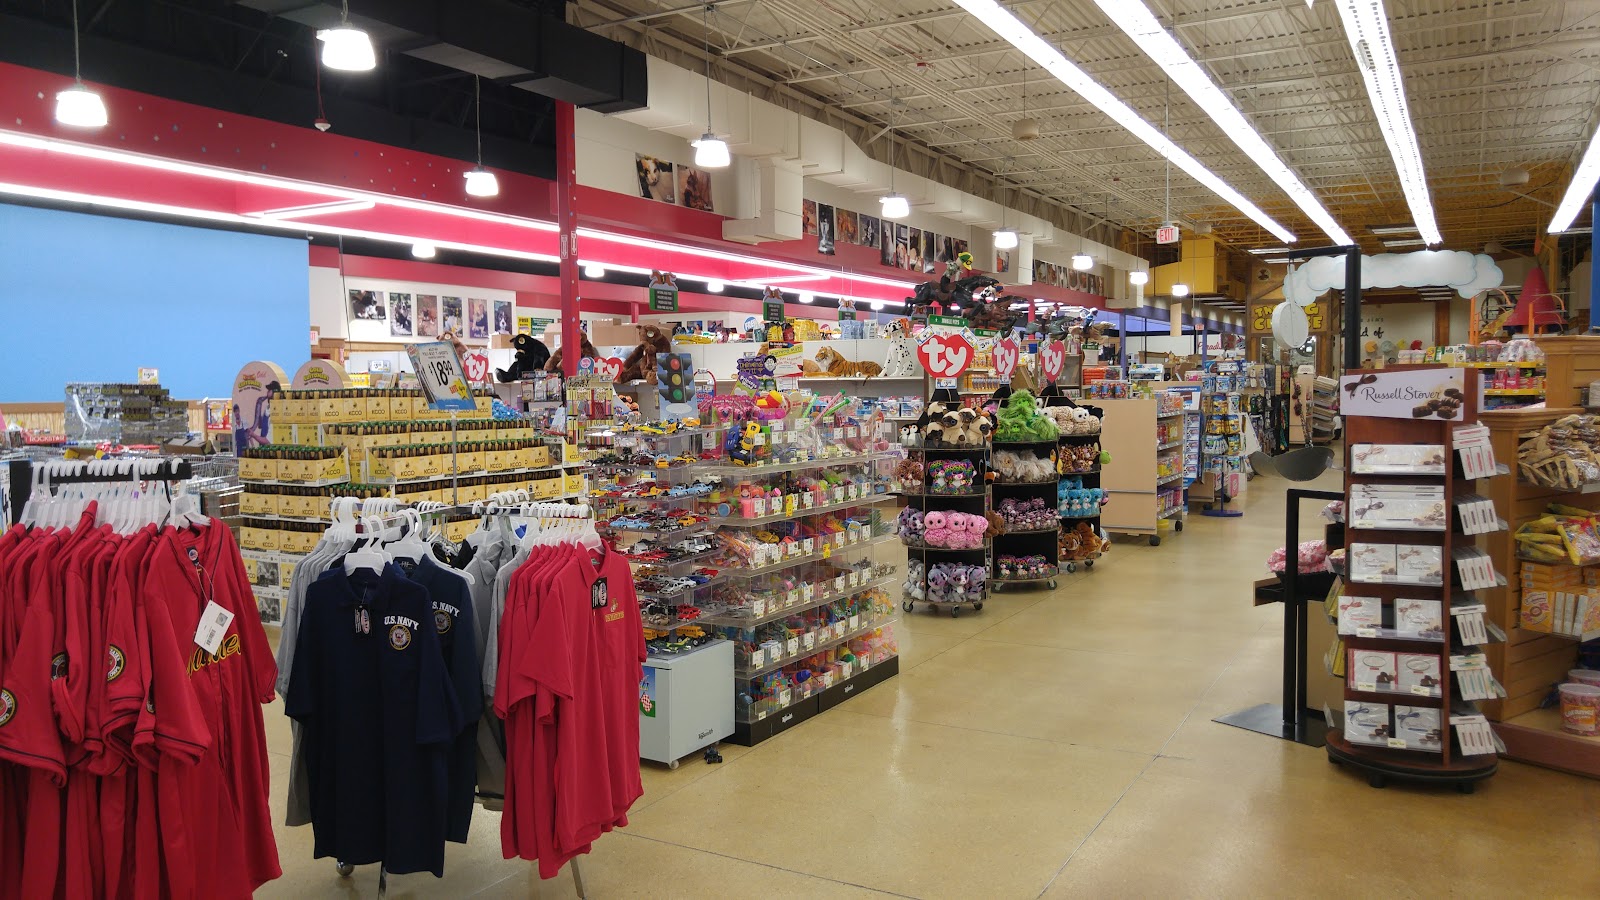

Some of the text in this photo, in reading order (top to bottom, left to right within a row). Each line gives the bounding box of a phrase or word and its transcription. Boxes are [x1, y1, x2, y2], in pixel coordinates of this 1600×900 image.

[1160, 228, 1173, 242] EXIT
[466, 354, 486, 380] ty
[922, 338, 967, 376] ty
[994, 342, 1015, 378] ty
[1042, 347, 1062, 376] ty
[594, 358, 620, 380] ty
[1361, 386, 1441, 403] Russell Stover
[439, 602, 460, 618] NAVY
[384, 616, 420, 630] U.S. NAVY
